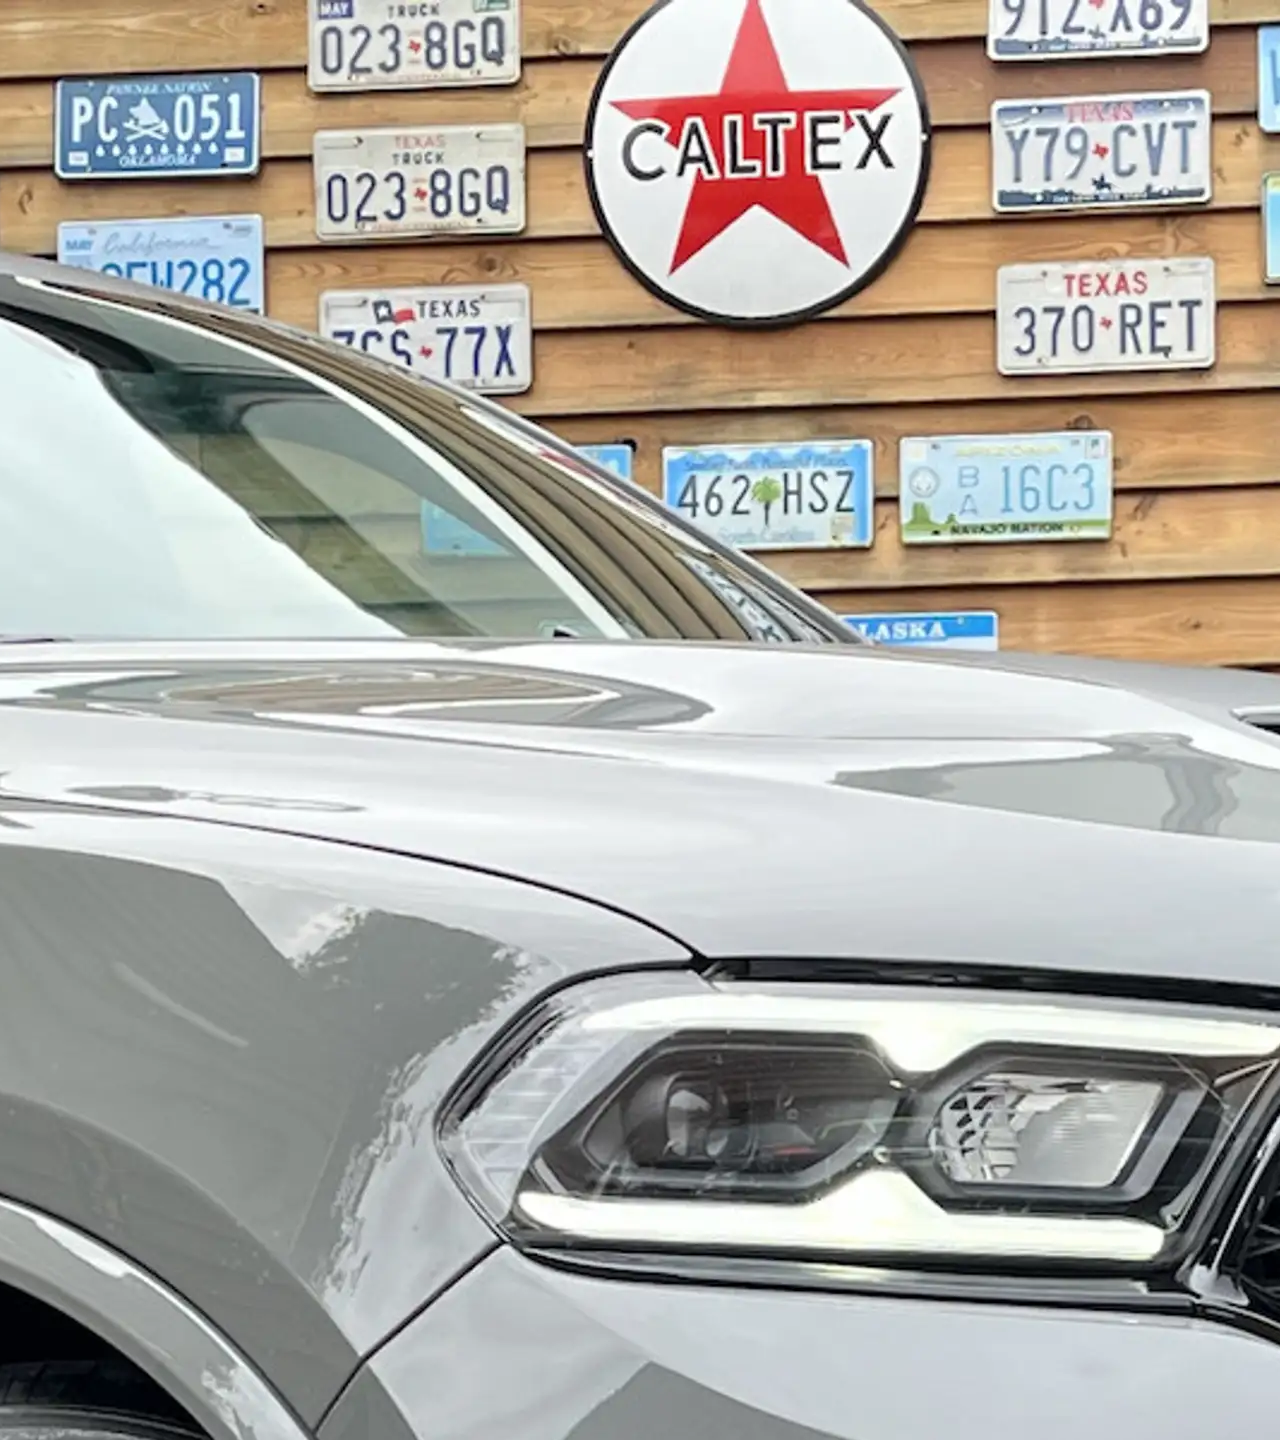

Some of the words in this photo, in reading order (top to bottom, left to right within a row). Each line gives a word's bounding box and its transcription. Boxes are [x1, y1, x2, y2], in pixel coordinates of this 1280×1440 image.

[320, 1, 348, 16] MAY
[388, 4, 440, 19] TRUCK
[321, 24, 401, 74] 023
[425, 16, 505, 70] 8GQ
[72, 96, 118, 142] PC
[174, 93, 245, 142] 051
[1065, 103, 1135, 123] TEXAS
[393, 152, 444, 165] TRUCK
[394, 134, 446, 149] TEXAS
[622, 113, 895, 181] CALTEX
[1006, 126, 1088, 183] Y79
[1113, 120, 1197, 177] CVT
[327, 171, 406, 222] 023
[430, 165, 509, 218] 8GQ
[1063, 271, 1148, 298] TEXAS
[416, 299, 481, 319] TEXAS
[1014, 304, 1095, 357] 370
[1120, 299, 1202, 354] RET
[436, 324, 516, 378] 77X
[677, 475, 751, 518] 462
[783, 470, 855, 514] HSZ
[1001, 463, 1095, 513] 16C3
[858, 621, 947, 641] LASKA
